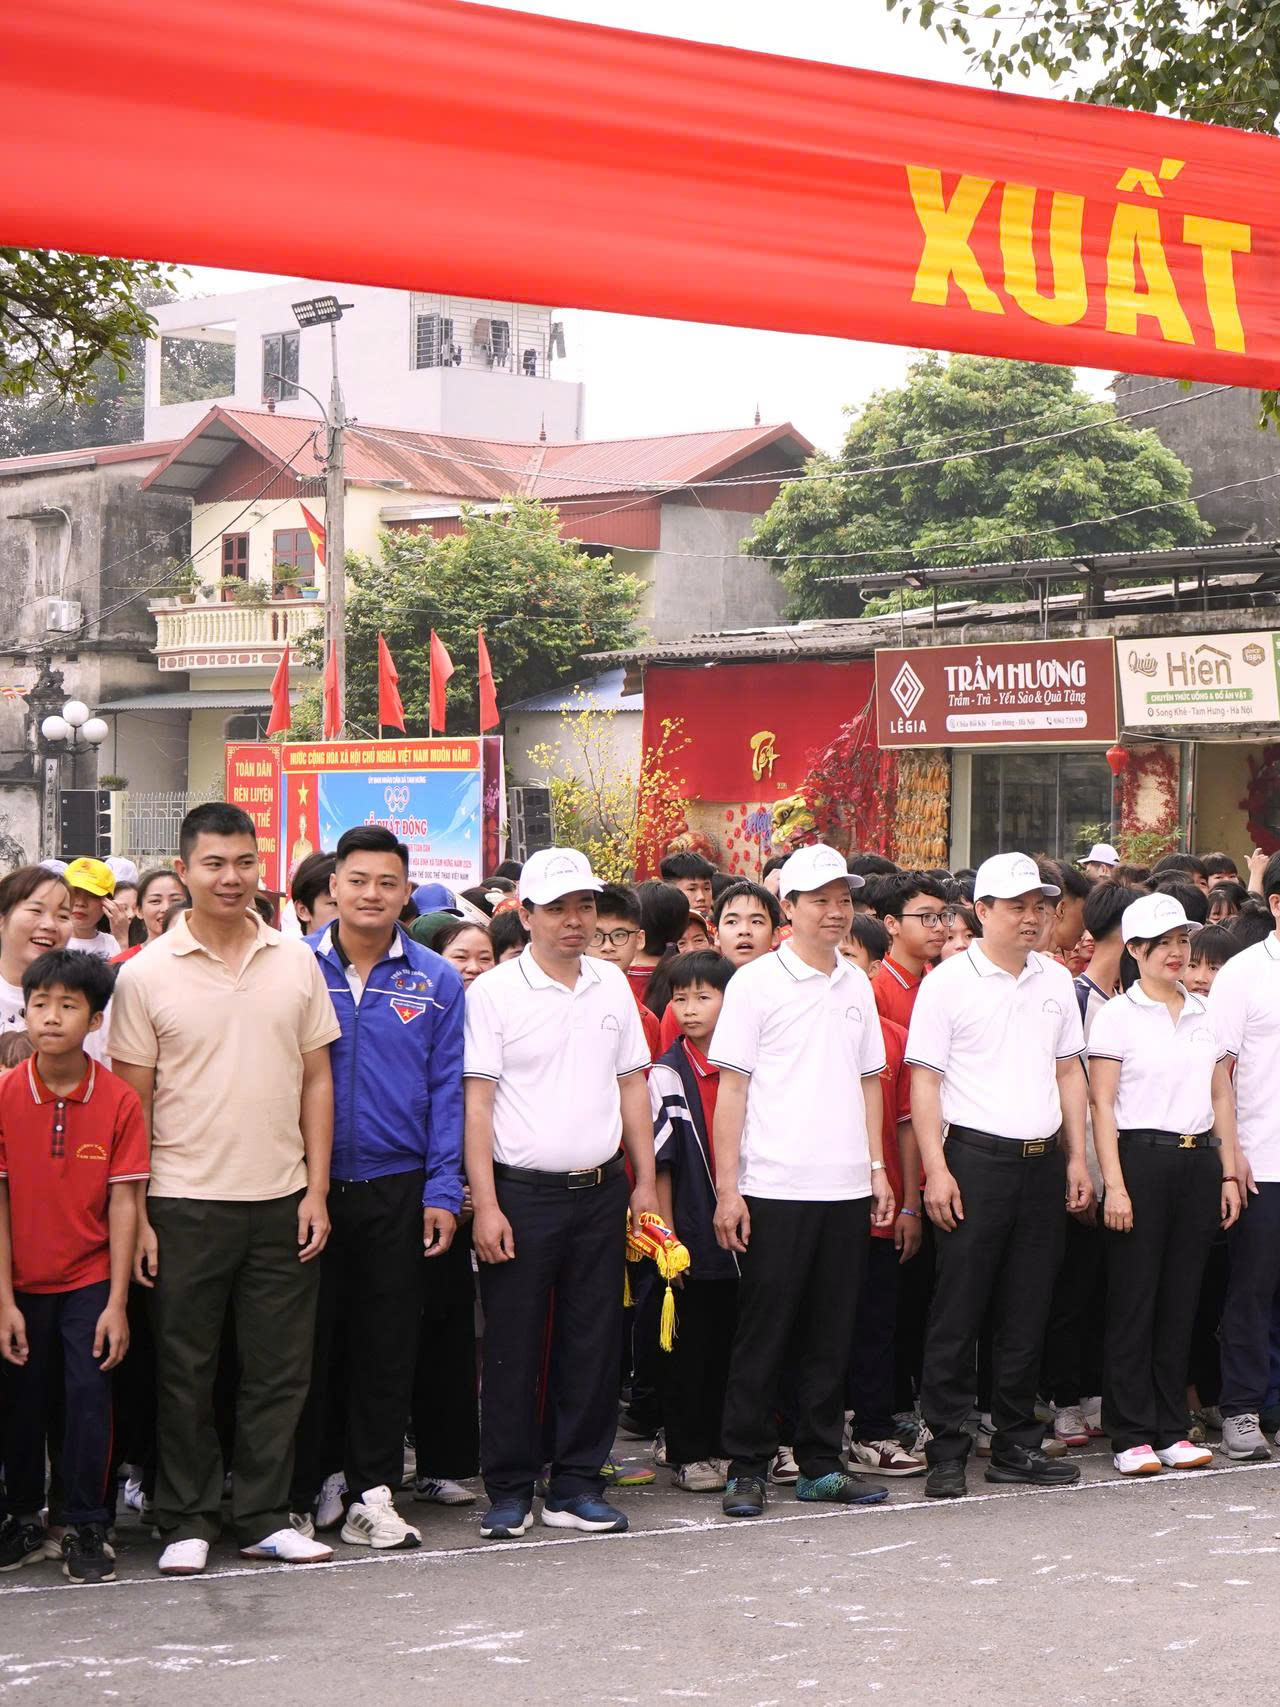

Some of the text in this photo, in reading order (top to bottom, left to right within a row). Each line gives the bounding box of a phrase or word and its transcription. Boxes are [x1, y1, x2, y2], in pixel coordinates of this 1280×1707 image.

[906, 158, 1251, 353] XUẤT
[944, 655, 1087, 691] TRẦM HƯƠNG
[1167, 644, 1232, 686] Hiên
[949, 692, 970, 706] Trầm
[976, 692, 991, 705] Trà
[999, 690, 1016, 704] Yến
[1017, 690, 1034, 704] Sào
[1035, 692, 1043, 704] &
[1043, 689, 1062, 705] Quà
[1063, 688, 1086, 705] Tặng
[1192, 707, 1205, 715] Tam
[1230, 706, 1239, 714] Hà
[290, 750, 307, 765] NƯỚC
[308, 749, 325, 767] CỘNG
[326, 748, 339, 764] HÒA
[340, 748, 349, 764] XÃ
[350, 748, 361, 767] HỘI
[362, 746, 375, 764] CHỦ
[376, 747, 396, 763] NGHĨA
[398, 746, 411, 766] VIỆT
[413, 748, 429, 763] NAM
[430, 746, 451, 762] MUÔN
[235, 760, 272, 777] TOÀN DÂN
[233, 784, 273, 805] RÈN LUYỆN
[402, 815, 427, 839] ĐỘNG
